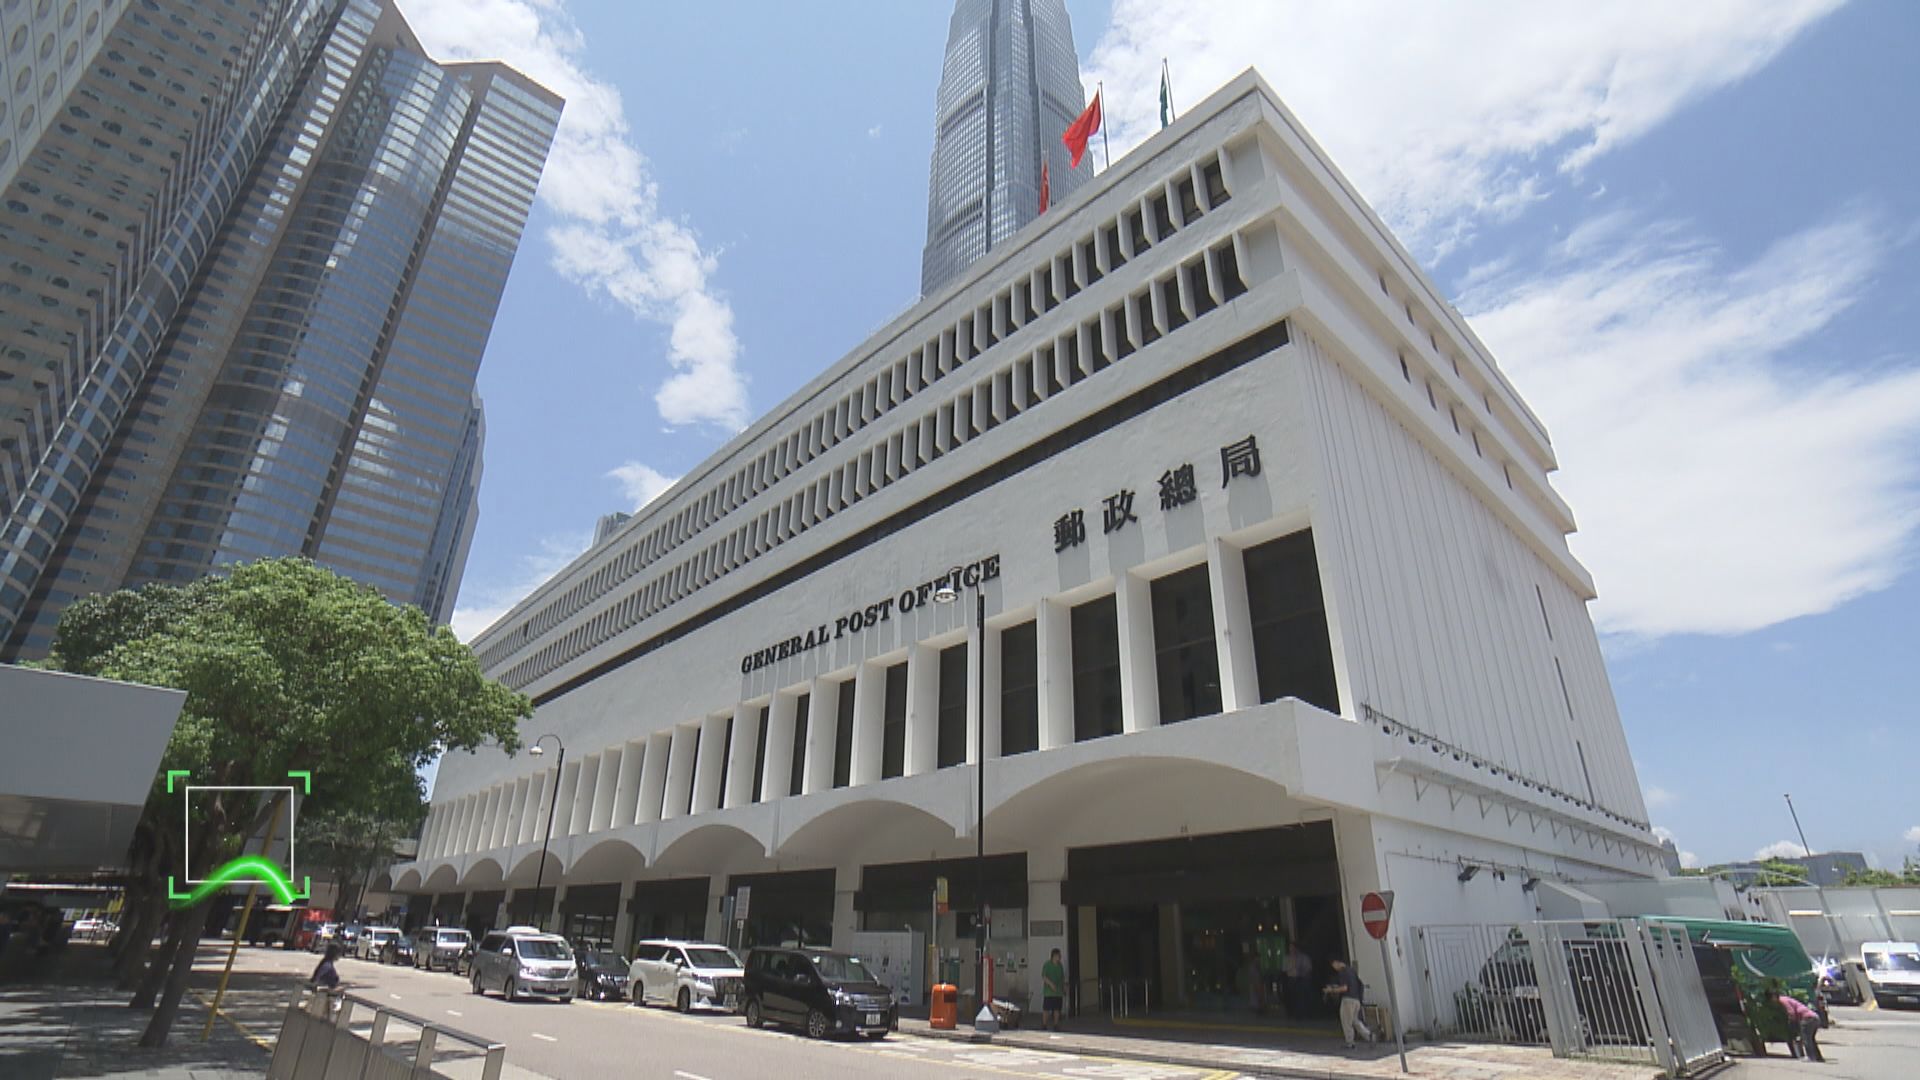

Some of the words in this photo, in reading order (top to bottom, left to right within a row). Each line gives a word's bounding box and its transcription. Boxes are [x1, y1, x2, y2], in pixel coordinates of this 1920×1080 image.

[1054, 434, 1261, 553] 郵政總局
[741, 624, 829, 674] GENERAL
[834, 598, 894, 639] POST
